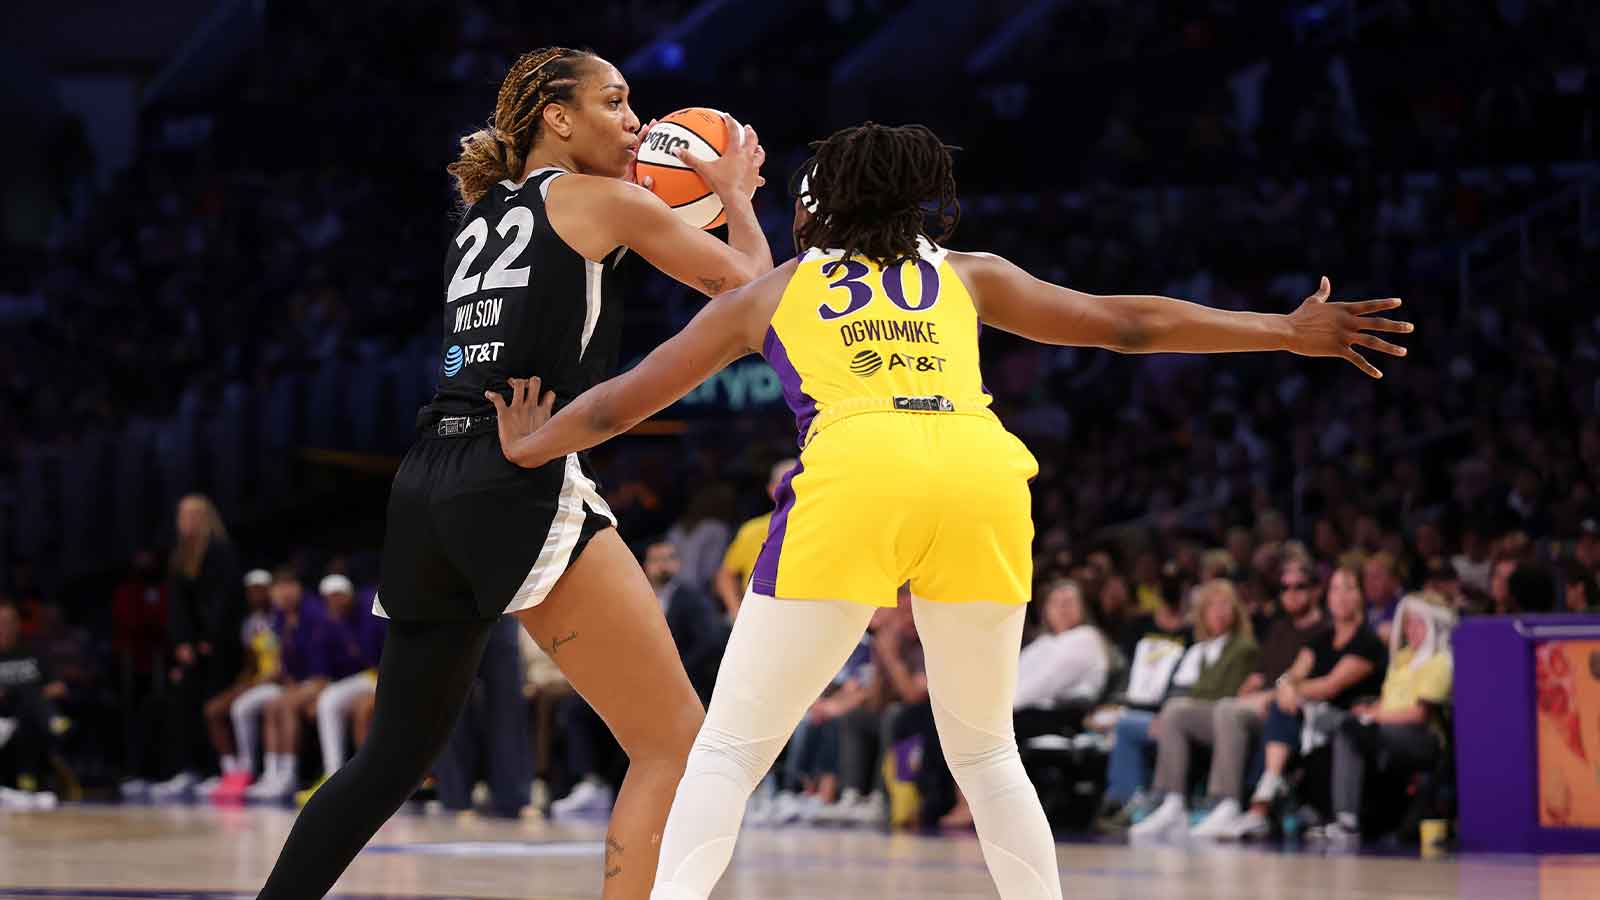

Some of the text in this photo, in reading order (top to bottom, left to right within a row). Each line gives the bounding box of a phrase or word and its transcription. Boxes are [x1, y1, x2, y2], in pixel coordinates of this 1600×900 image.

[447, 206, 535, 303] 22
[818, 258, 940, 319] 30
[453, 298, 503, 333] WILSON
[840, 319, 940, 347] OGWUMIKE
[464, 342, 505, 368] AT&T
[888, 353, 947, 372] AT&T
